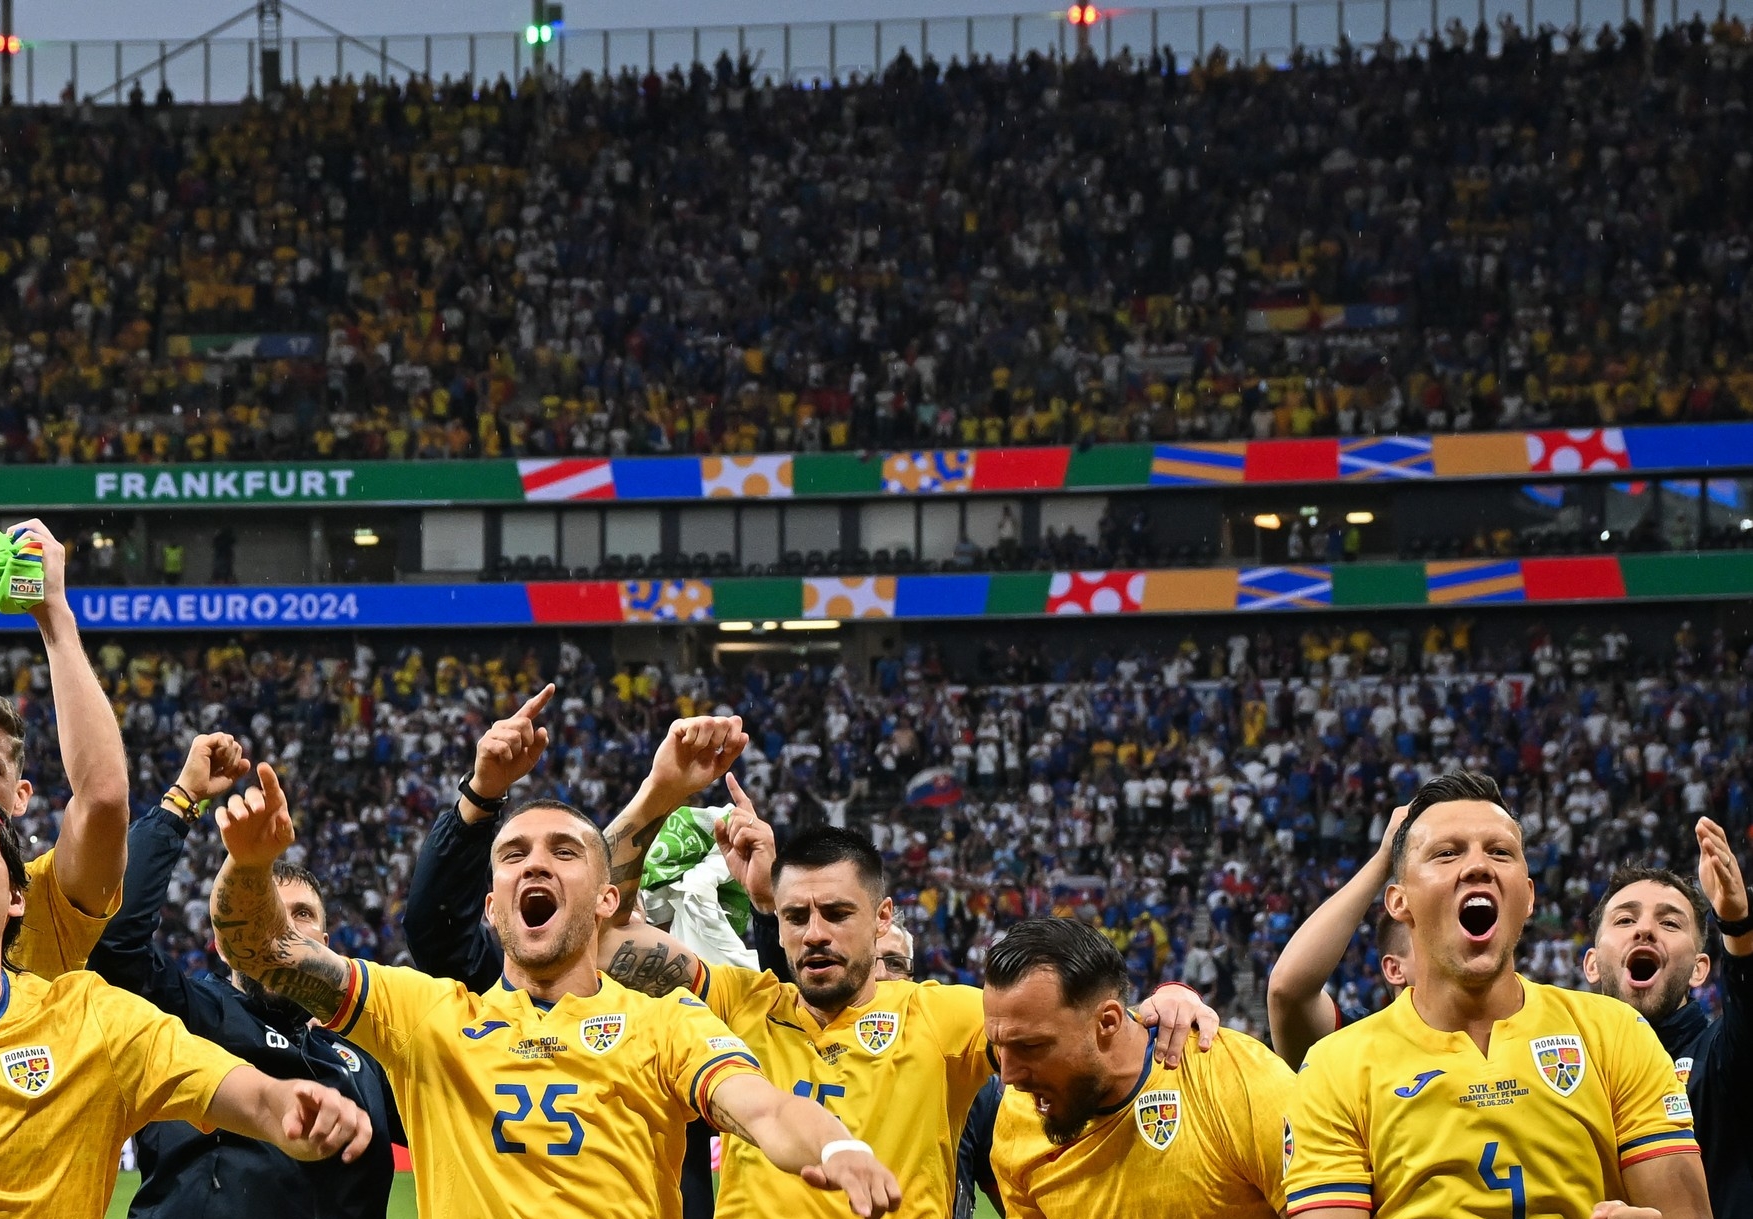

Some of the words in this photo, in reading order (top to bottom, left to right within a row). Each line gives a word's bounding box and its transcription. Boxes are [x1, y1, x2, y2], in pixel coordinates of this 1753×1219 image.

[96, 469, 355, 499] FRANKFURT
[266, 1031, 289, 1049] CD
[518, 1038, 535, 1049] SVK
[540, 1037, 558, 1046] ROU
[1535, 1037, 1577, 1050] ROMÂNIA
[5, 1048, 46, 1062] ROMÂNIA
[1468, 1084, 1489, 1094] SVK
[1496, 1079, 1517, 1091] ROU
[1138, 1091, 1177, 1106] ROMÂNIA
[1459, 1093, 1500, 1103] FRANKFURT
[1511, 1088, 1529, 1097] MAIN
[1477, 1098, 1514, 1108] 26.06.2024
[491, 1083, 586, 1155] 25
